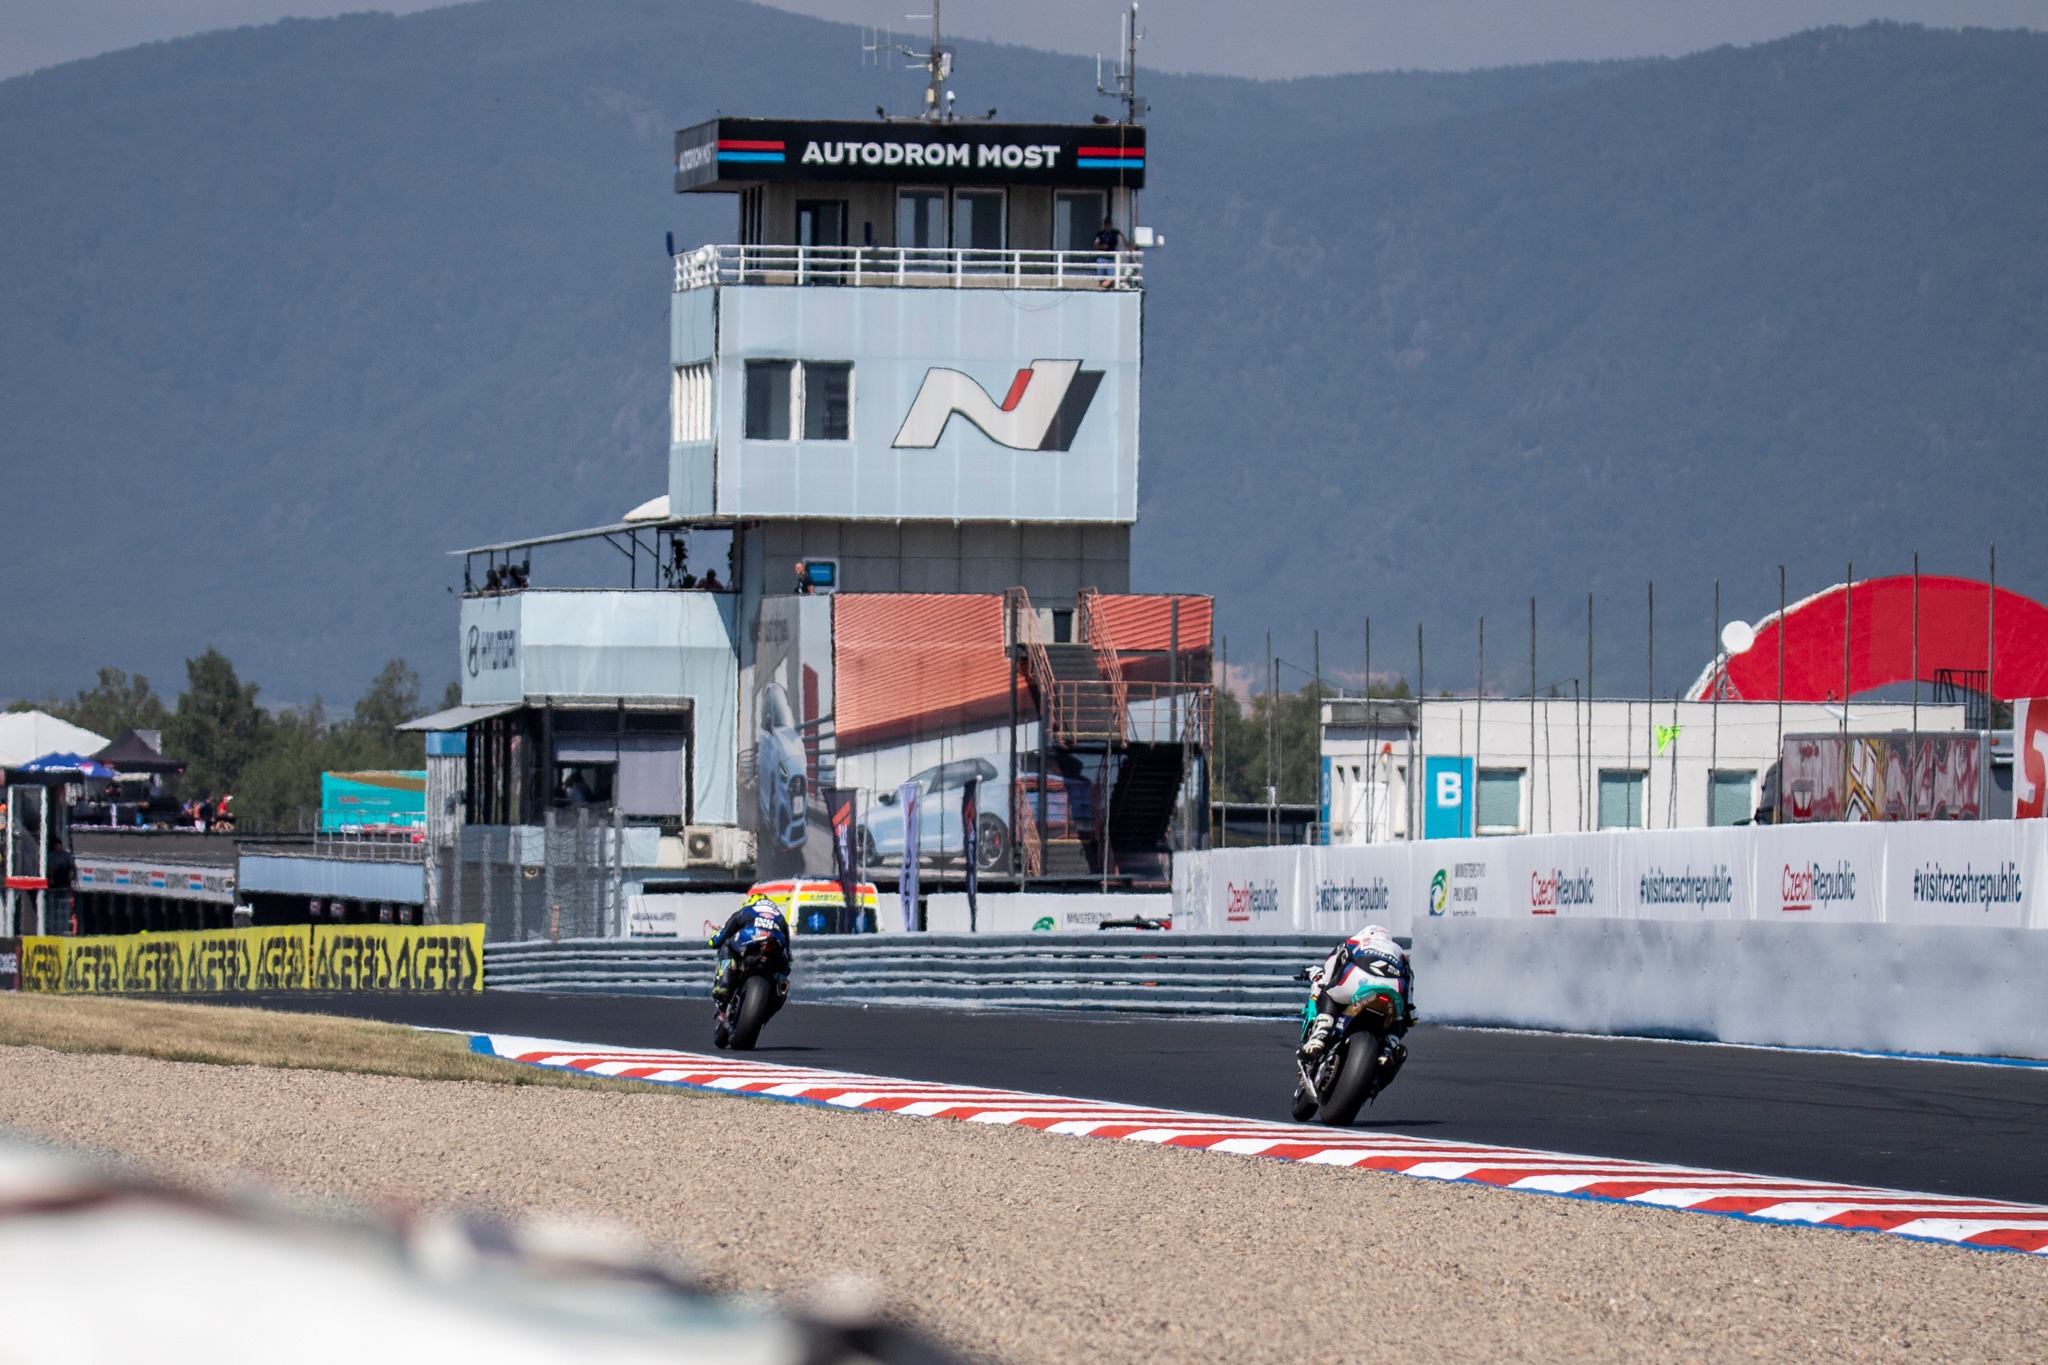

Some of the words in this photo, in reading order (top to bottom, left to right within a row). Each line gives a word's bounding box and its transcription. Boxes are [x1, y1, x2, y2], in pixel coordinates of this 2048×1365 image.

[801, 141, 970, 168] AUTODROM
[977, 144, 1060, 168] MOST
[1436, 771, 1461, 807] B
[1531, 867, 1594, 912] CzechRepublic
[1640, 864, 1732, 911] #visitczechrepublic
[1782, 861, 1856, 908] CzechRepublic
[1913, 862, 2022, 912] #visitczechrepublic
